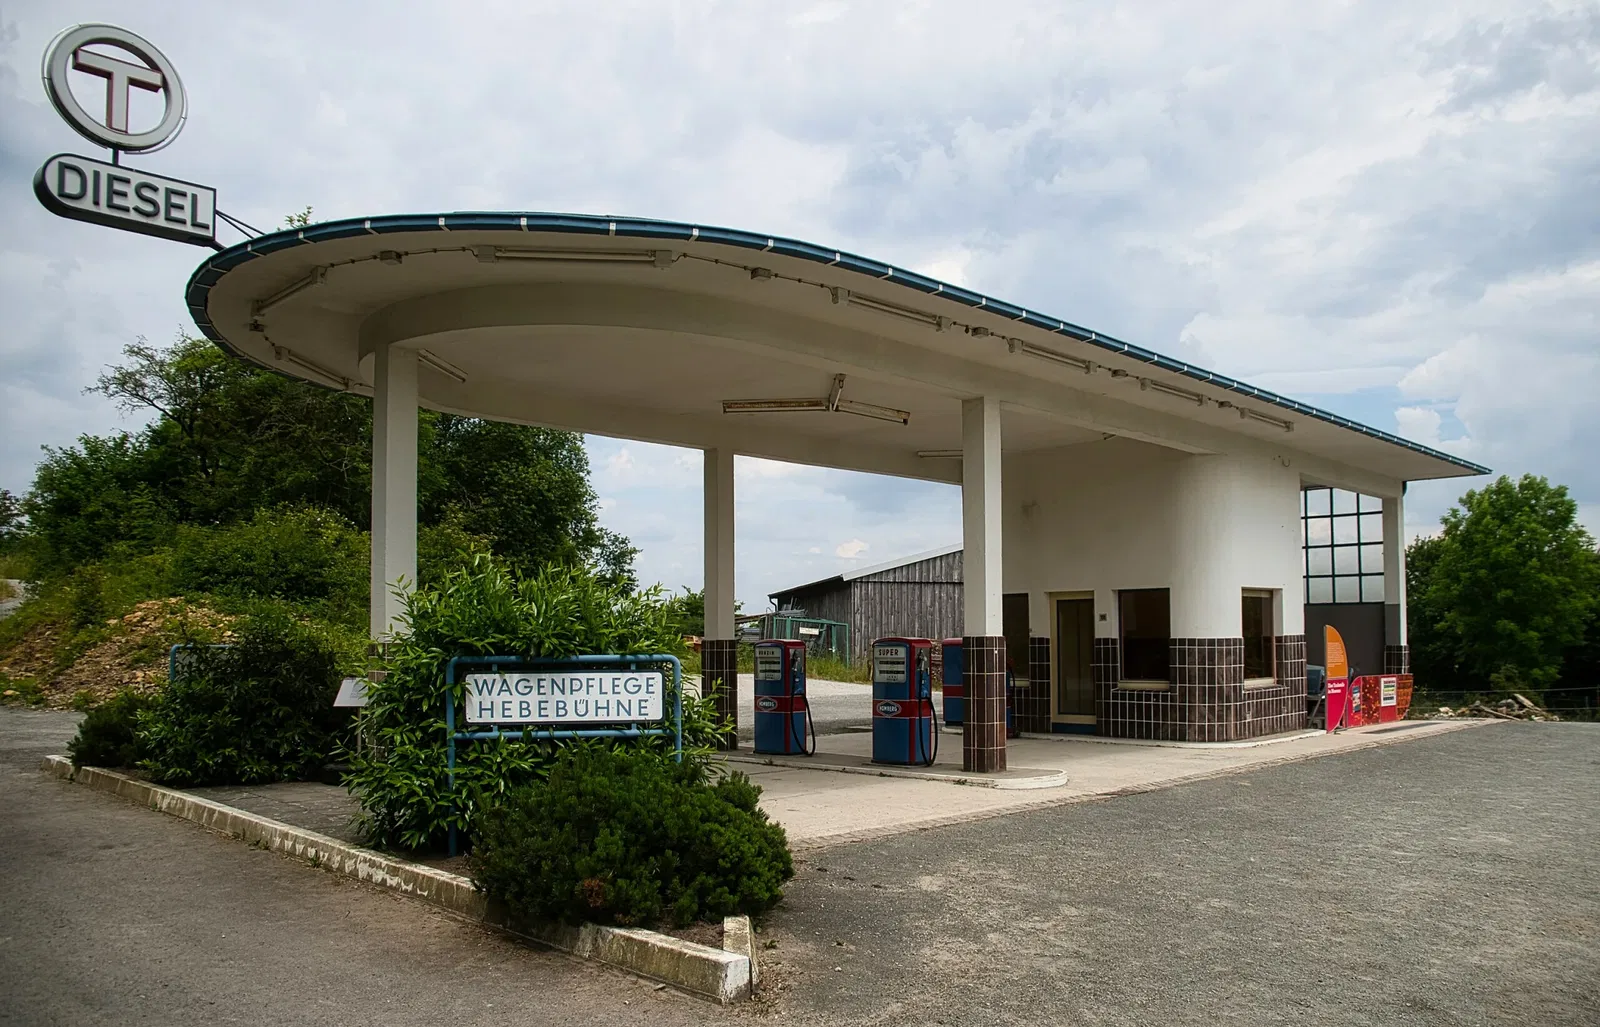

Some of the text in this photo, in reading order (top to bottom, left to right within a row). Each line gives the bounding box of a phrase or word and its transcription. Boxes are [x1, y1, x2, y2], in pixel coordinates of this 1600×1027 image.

[57, 161, 210, 230] DIESEL
[878, 648, 899, 656] SUPER
[473, 677, 656, 696] WAGENPFLEGE
[478, 699, 649, 718] HEBEBÜHNE
